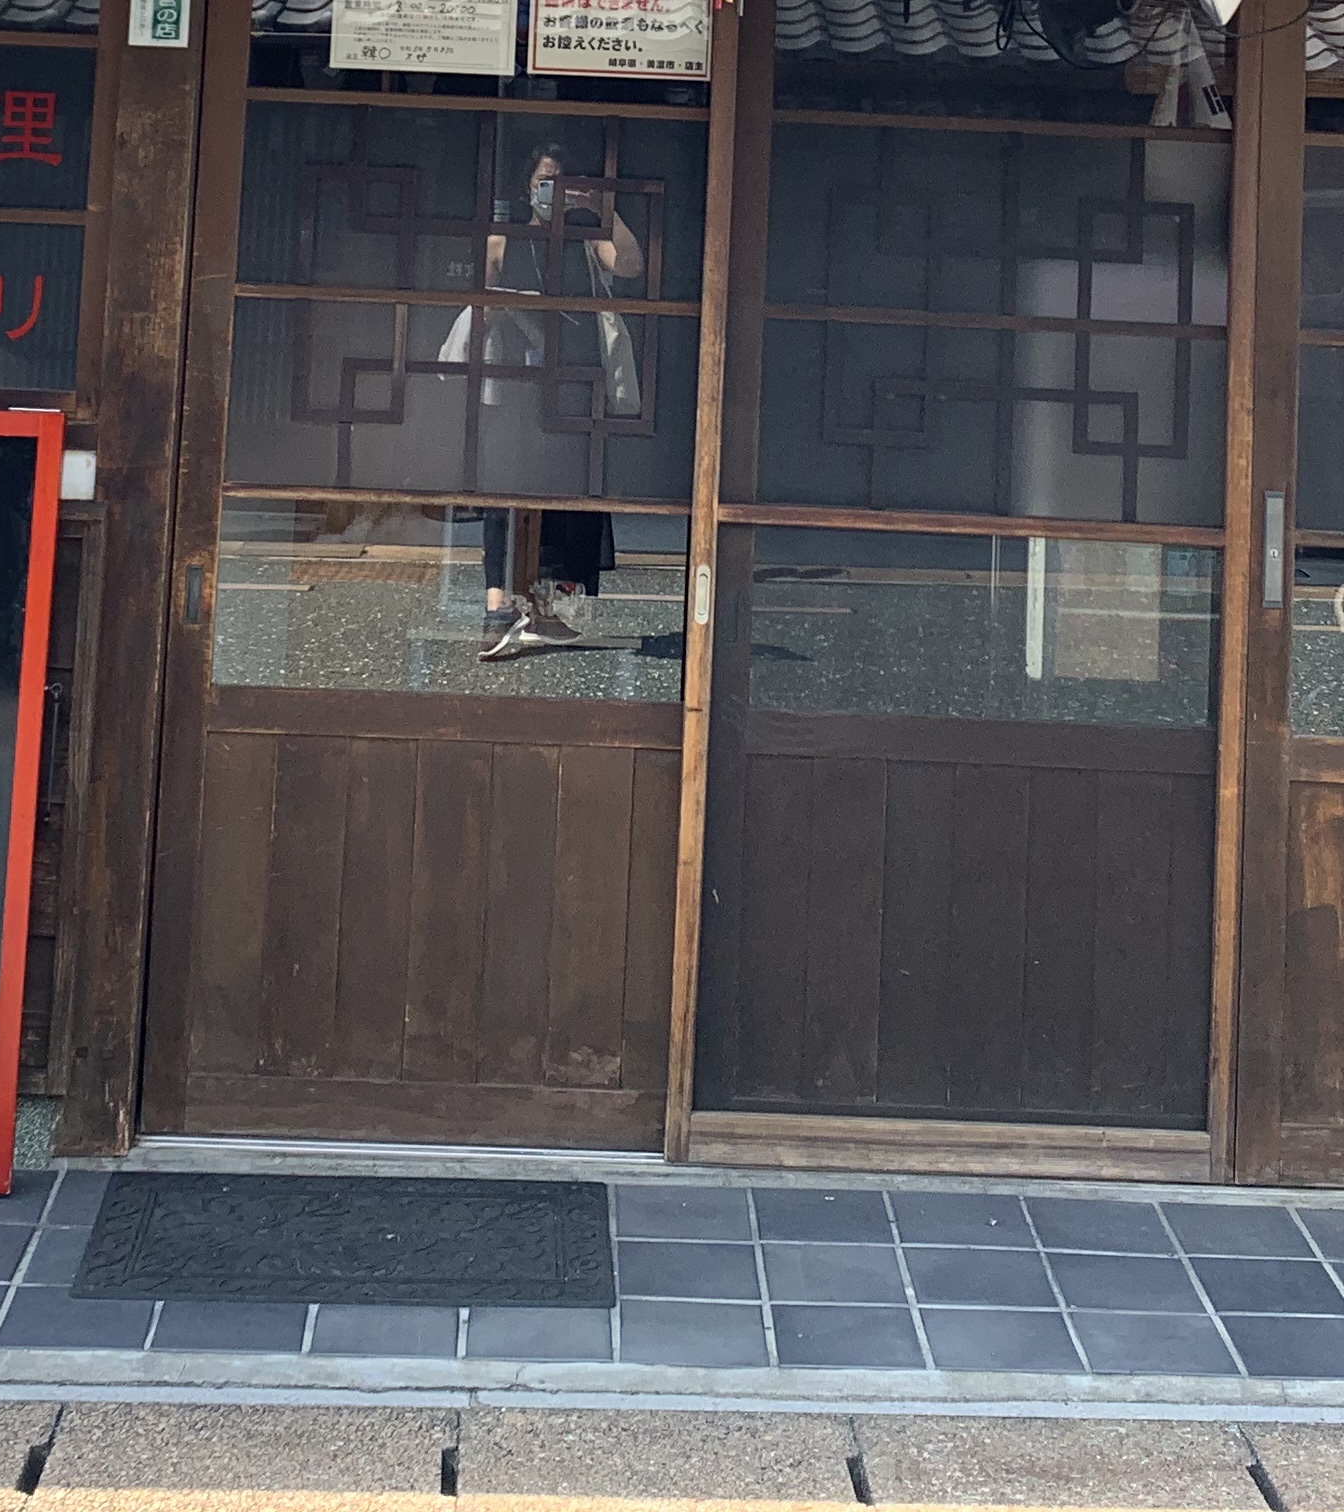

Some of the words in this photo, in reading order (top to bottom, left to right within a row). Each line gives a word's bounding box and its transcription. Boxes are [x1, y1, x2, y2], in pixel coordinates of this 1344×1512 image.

[541, 34, 644, 53] お控えください。
